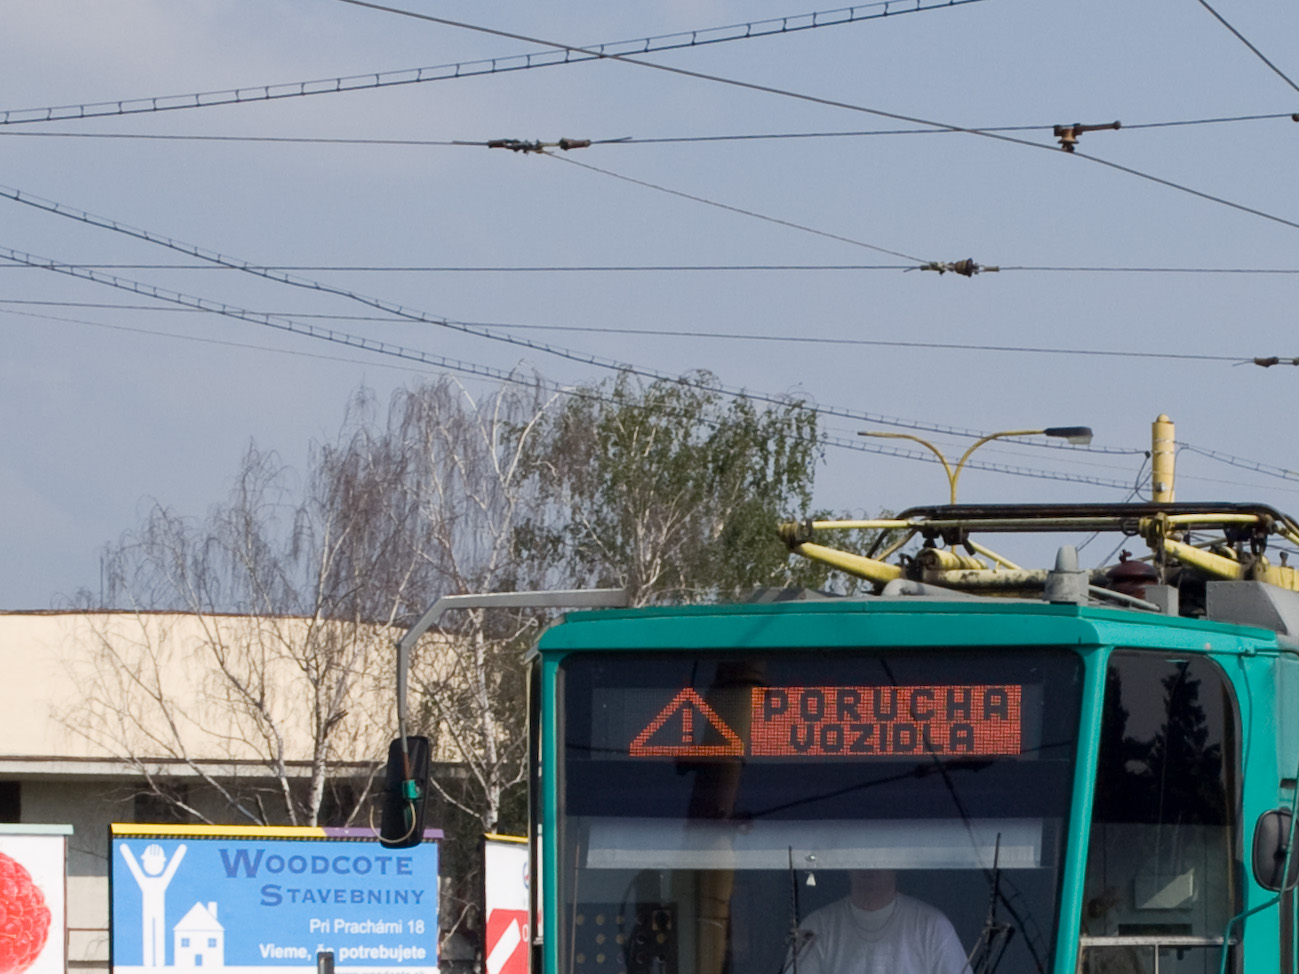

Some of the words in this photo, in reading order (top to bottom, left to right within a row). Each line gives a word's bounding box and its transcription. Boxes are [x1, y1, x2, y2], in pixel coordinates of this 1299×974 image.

[763, 689, 1008, 722] PORUCHA
[790, 723, 974, 753] VOZIDLA
[219, 849, 413, 878] WOODCOTE
[260, 884, 424, 906] STAVEBNINY
[310, 919, 330, 934] Pri
[408, 919, 425, 934] 18
[259, 944, 312, 961] Vieme,
[339, 945, 426, 962] potrebujete
